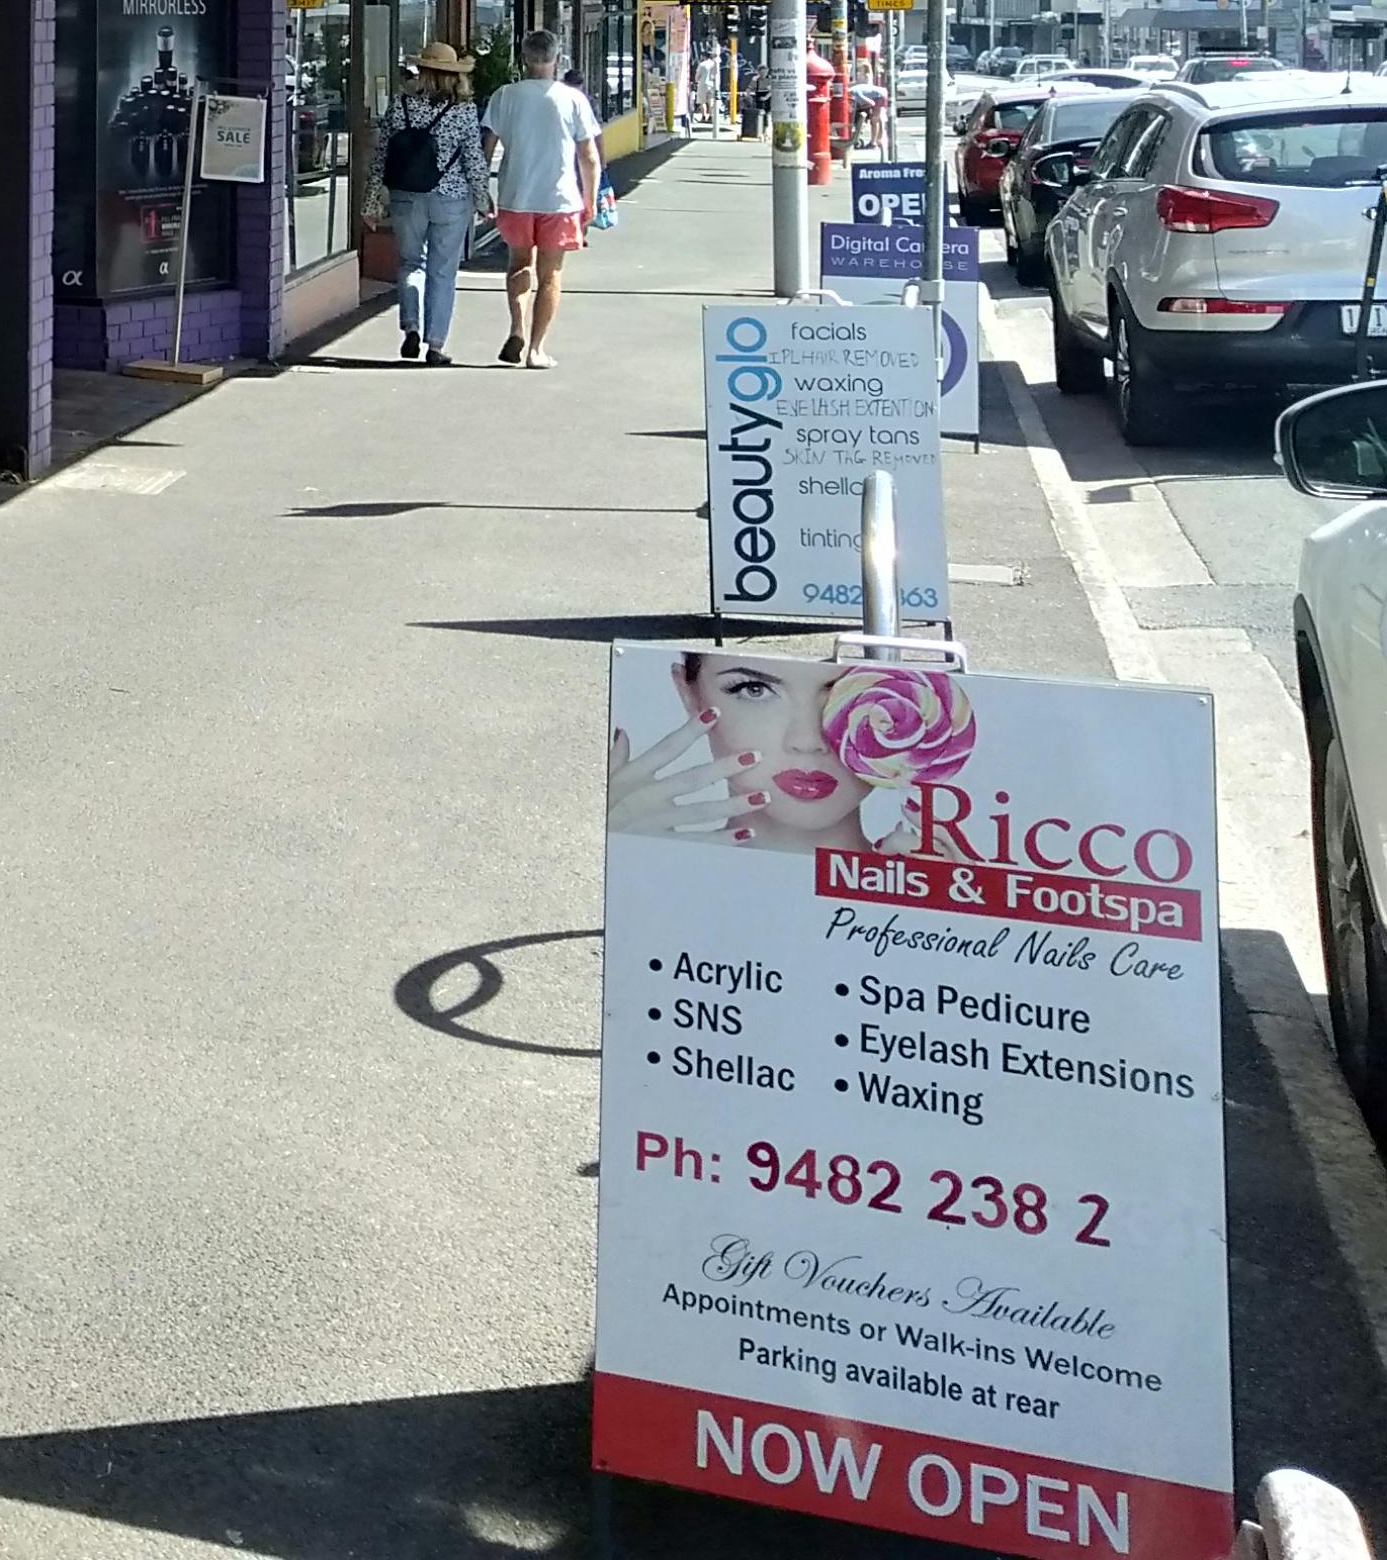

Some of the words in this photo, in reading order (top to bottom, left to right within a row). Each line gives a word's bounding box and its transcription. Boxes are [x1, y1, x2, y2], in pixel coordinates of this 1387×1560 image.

[217, 129, 251, 144] SALE
[859, 167, 901, 179] Aroma
[831, 234, 889, 255] Digital
[896, 236, 969, 255] Caera
[832, 257, 968, 271] WAREHOSE
[791, 322, 867, 341] facials
[795, 375, 883, 397] waxing
[716, 317, 783, 602] beautyglo
[797, 428, 862, 448] spray
[869, 425, 920, 445] tans
[799, 477, 864, 495] shella
[803, 583, 863, 605] 9482
[910, 781, 1194, 885] Ricco
[829, 858, 930, 899] Nails
[948, 869, 986, 905] &
[1006, 874, 1184, 932] Footspa
[826, 907, 1003, 959] Professional
[1014, 932, 1097, 972] Nails
[1110, 942, 1184, 982] Care
[673, 952, 784, 997] Acrylic
[673, 999, 743, 1037] SNS
[858, 975, 926, 1016] Spa
[938, 983, 1092, 1034] Pedicure
[672, 1046, 796, 1092] Shellac
[860, 1023, 991, 1072] Eyelash
[1001, 1046, 1196, 1100] Extensions
[858, 1074, 985, 1126] Waxing
[635, 1130, 722, 1184] Ph:
[746, 1139, 903, 1215] 9482
[927, 1169, 1050, 1236] 238
[1074, 1192, 1112, 1249] 2
[701, 1232, 774, 1284] Gift
[784, 1248, 930, 1309] Vouchers
[942, 1275, 1117, 1341] Available
[662, 1282, 851, 1337] Appointments
[859, 1320, 887, 1343] or
[894, 1322, 1017, 1368] Walk-ins
[1025, 1345, 1163, 1395] Welcome
[738, 1337, 838, 1385] Parking
[845, 1361, 963, 1403] available
[971, 1380, 997, 1410] at
[1005, 1389, 1061, 1421] rear
[695, 1409, 883, 1503] NOW
[907, 1453, 1131, 1555] OPEN
